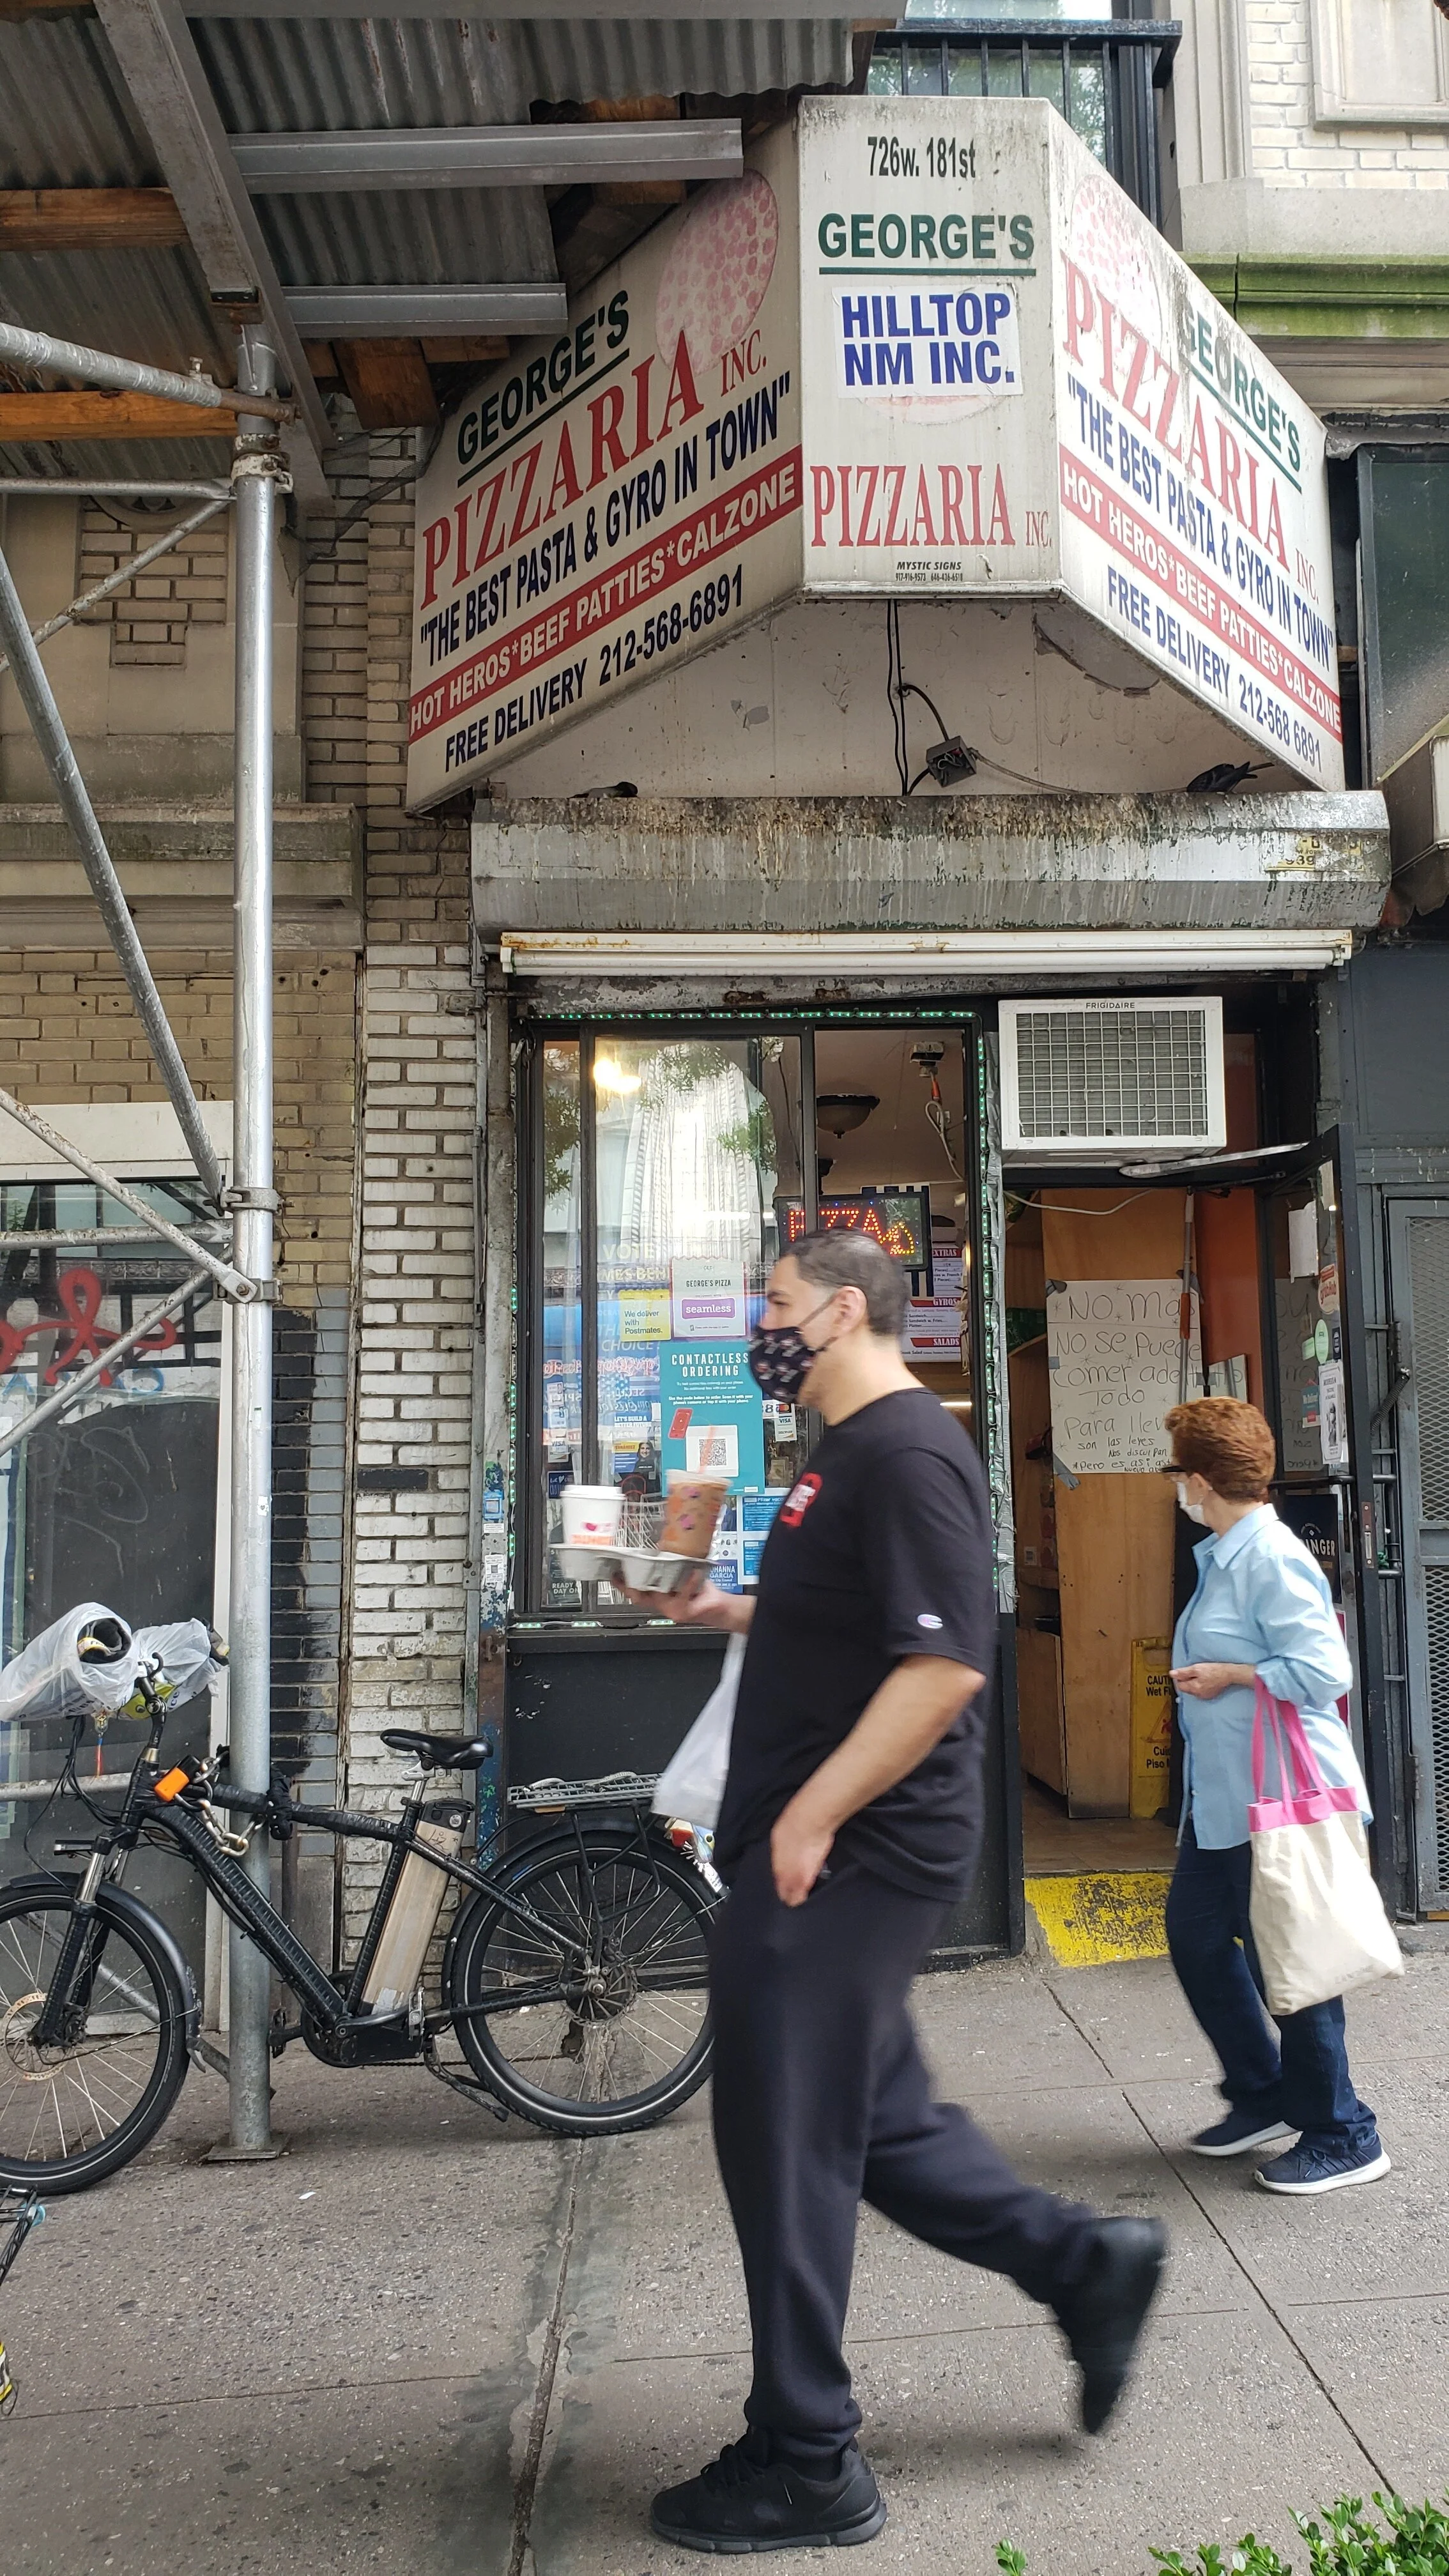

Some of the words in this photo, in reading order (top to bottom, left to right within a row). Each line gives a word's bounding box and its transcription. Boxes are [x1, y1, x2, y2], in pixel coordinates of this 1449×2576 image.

[926, 137, 976, 178] 181st
[818, 213, 1035, 260] GEORGE'S
[841, 293, 1011, 339] HILLTOP
[457, 290, 629, 465] GEORGE'S
[843, 341, 914, 386] NM
[929, 340, 1015, 385] INC.
[1179, 300, 1301, 472] GEORGE'S
[1059, 249, 1291, 573] PIZZARIA
[1296, 548, 1319, 605] INC.
[420, 330, 704, 611] PIZZARIA
[720, 329, 767, 396] INC.
[810, 463, 1016, 548] PIZZARIA
[1025, 510, 1053, 549] INC.
[1063, 466, 1104, 524] HOT
[466, 565, 511, 645] BEST
[517, 522, 576, 609] PASTA
[584, 506, 598, 562] &
[606, 459, 666, 548] GYRO
[675, 436, 698, 505] IN
[1119, 422, 1162, 514] BEST
[1167, 469, 1216, 567] PASTA
[1221, 521, 1232, 576] &
[1236, 537, 1274, 617] GYRO
[1277, 575, 1292, 635] IN
[896, 562, 931, 570] MYSTIC
[933, 562, 962, 570] SIGNS
[1108, 565, 1151, 638] FREE
[1156, 605, 1230, 698] DELIVERY
[445, 716, 489, 773] FREE
[494, 657, 588, 746] DELIVERY
[599, 563, 743, 687] 212-568-6891
[410, 686, 446, 736] HOT
[602, 1243, 655, 1260] VOTE
[686, 1304, 732, 1314] seamless
[671, 1353, 749, 1365] CONTACTLESS
[682, 1365, 739, 1377] ORDERING
[1078, 1441, 1097, 1450] son
[1107, 1437, 1122, 1446] las
[1146, 1687, 1162, 1696] Wet
[1146, 1759, 1165, 1769] Piso
